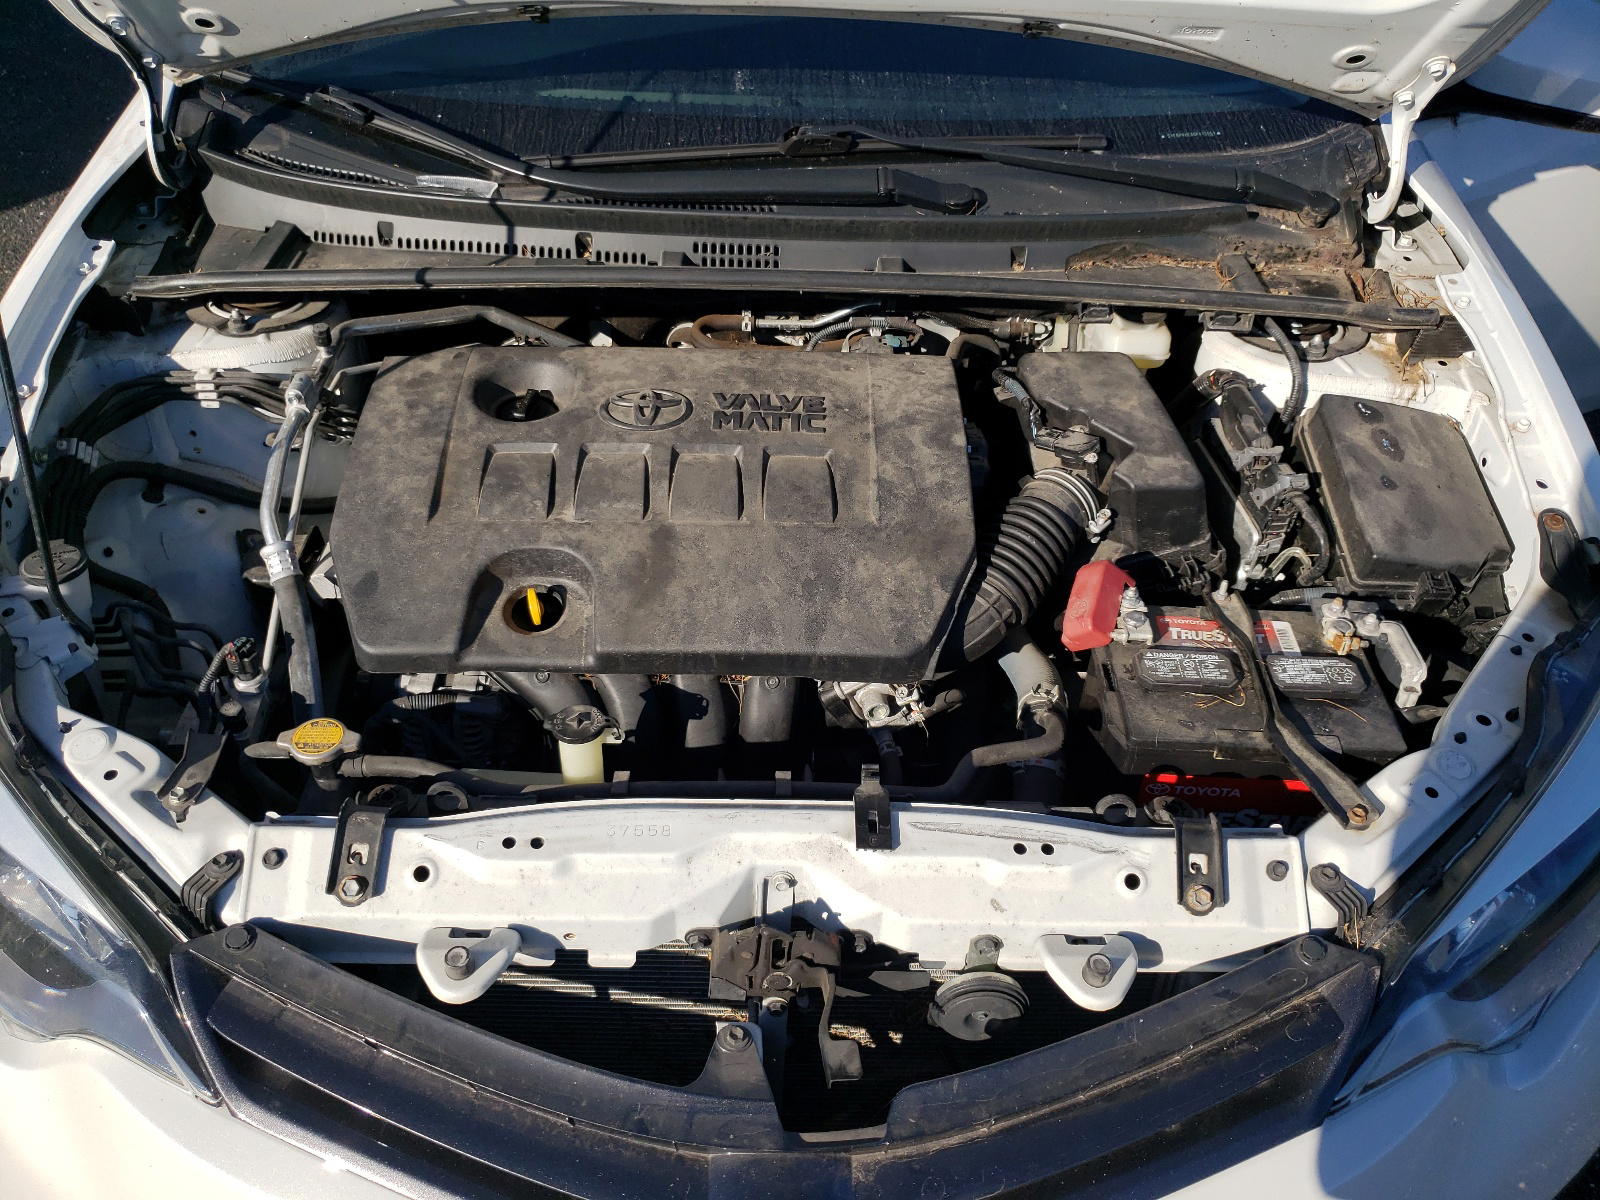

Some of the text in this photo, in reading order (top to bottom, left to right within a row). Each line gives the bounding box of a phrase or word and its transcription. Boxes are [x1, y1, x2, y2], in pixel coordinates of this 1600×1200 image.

[712, 392, 827, 413] VALVE
[712, 410, 827, 434] MATIC
[1174, 618, 1207, 626] TOYOTA
[1174, 785, 1241, 798] TOYOTA
